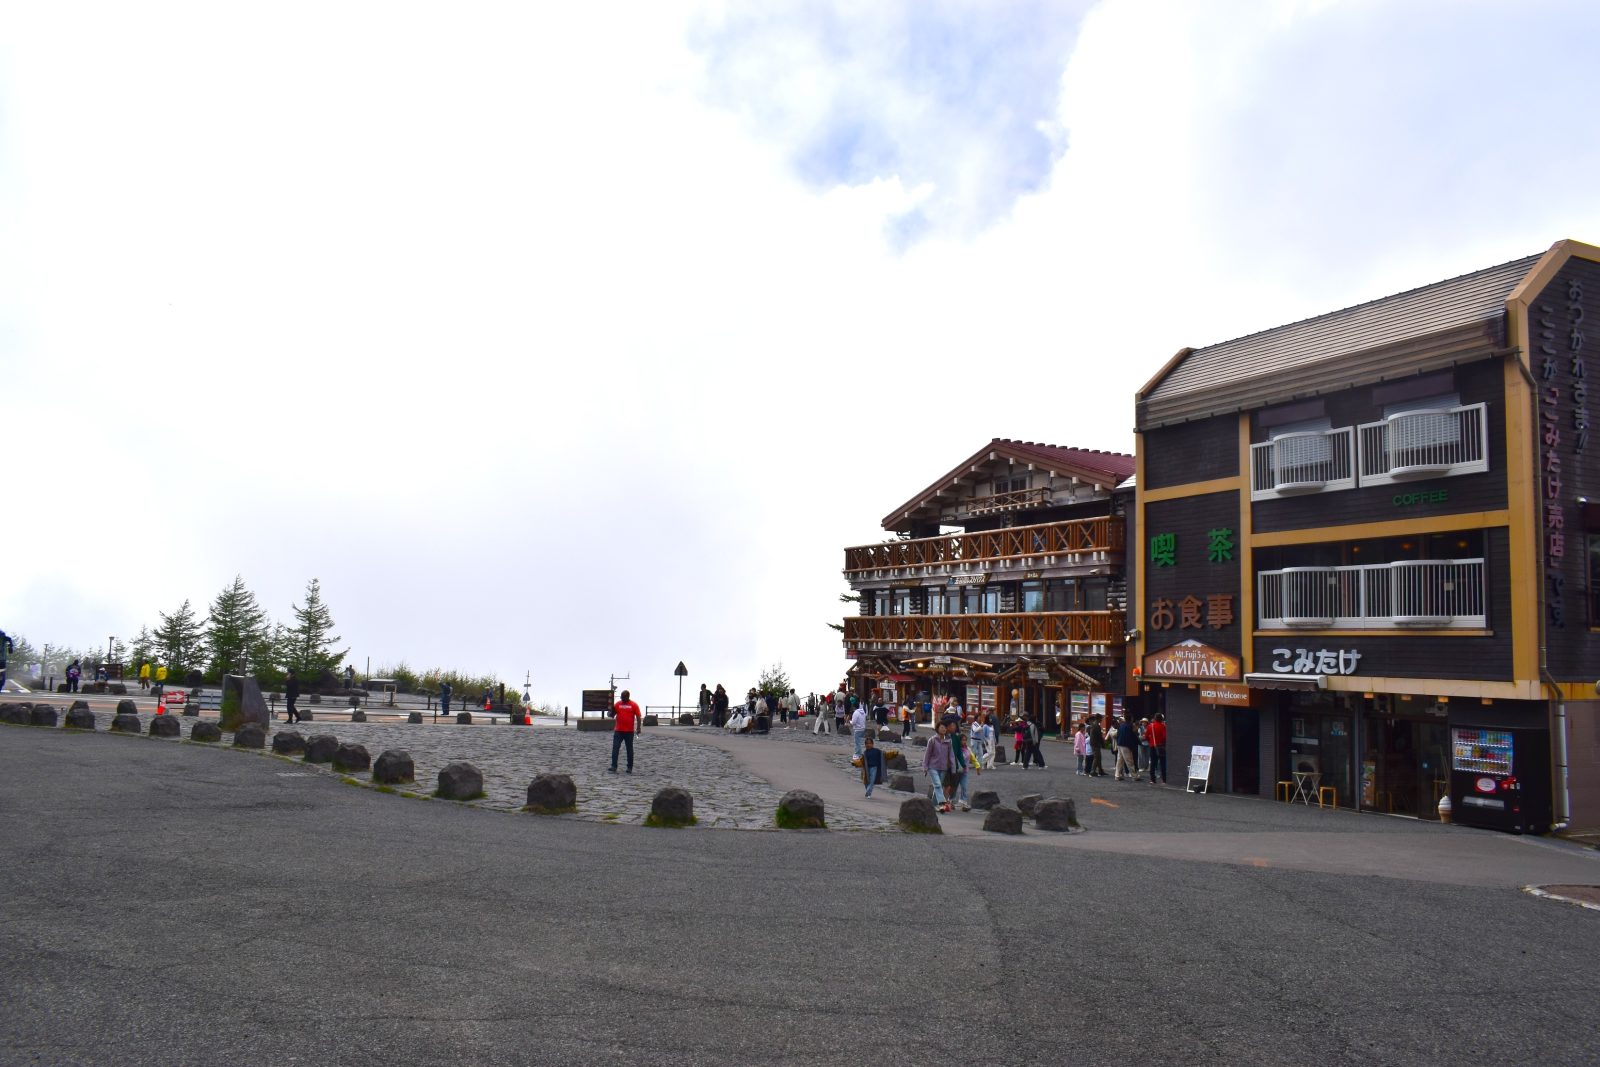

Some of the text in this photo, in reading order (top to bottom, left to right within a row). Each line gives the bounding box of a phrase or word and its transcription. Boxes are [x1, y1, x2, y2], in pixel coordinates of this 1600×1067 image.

[1393, 489, 1449, 506] COFFEE
[1150, 594, 1234, 630] お食事
[1155, 659, 1226, 677] KOMITAKE
[1271, 648, 1362, 674] こみたけ
[1217, 691, 1248, 700] Welcome
